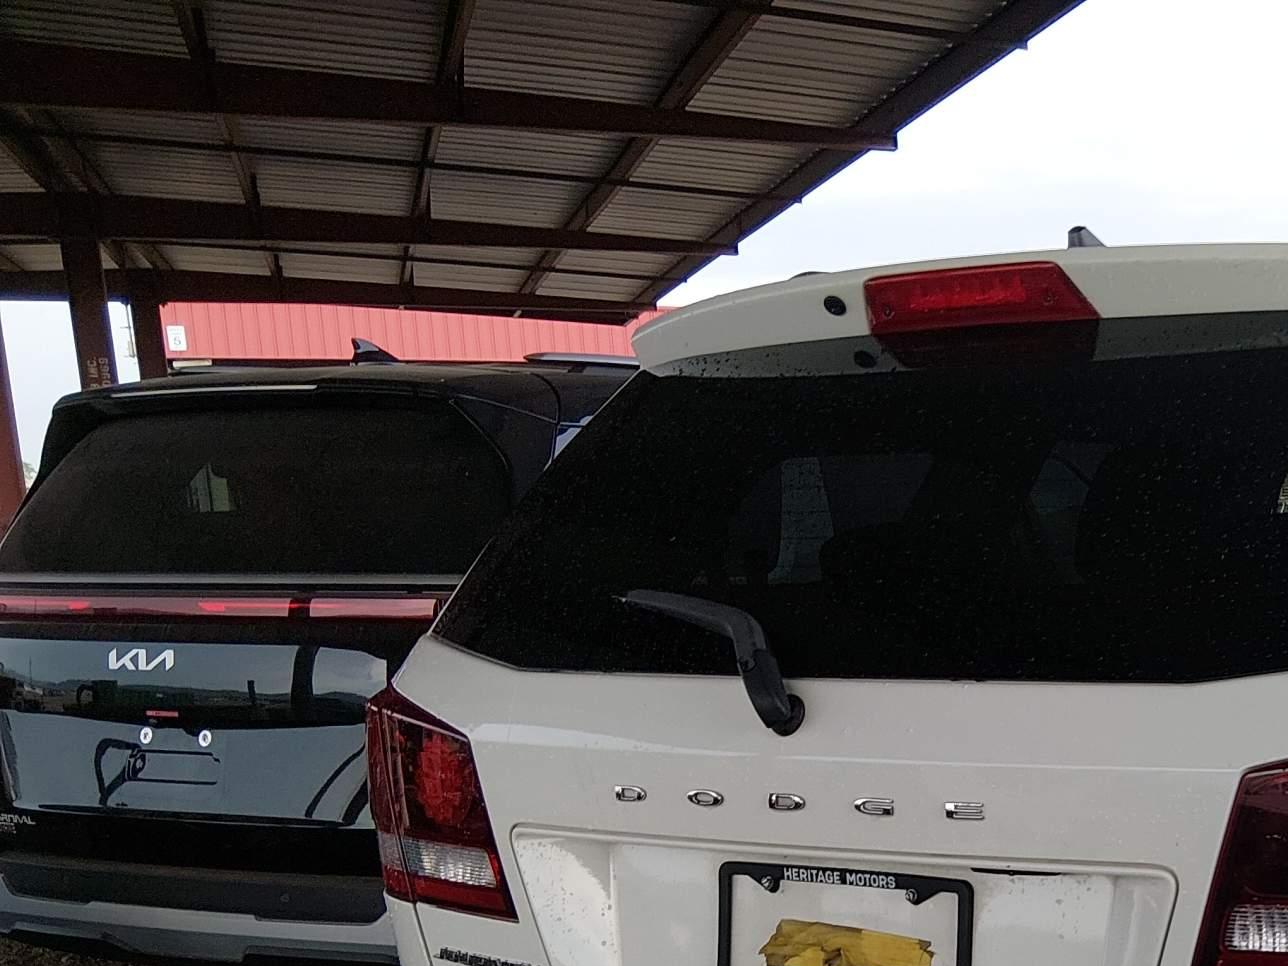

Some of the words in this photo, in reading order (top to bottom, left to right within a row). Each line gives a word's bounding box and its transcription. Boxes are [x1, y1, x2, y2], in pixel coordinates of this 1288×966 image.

[614, 784, 985, 821] DODGE
[783, 867, 842, 885] HERITAGE
[846, 872, 896, 889] MOTORS
